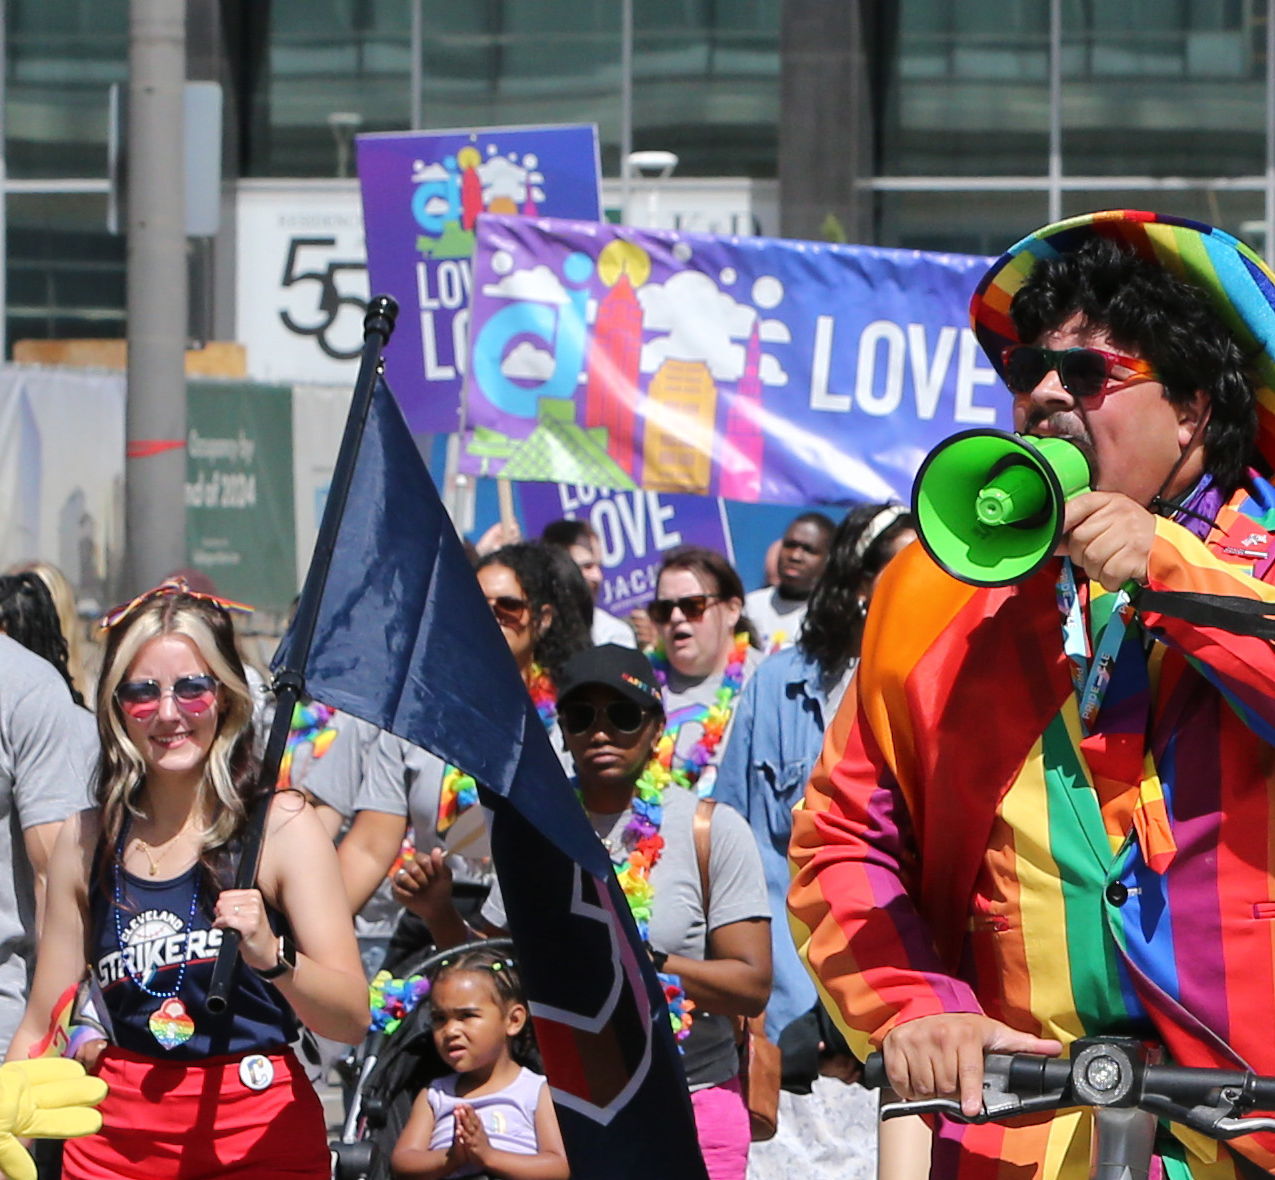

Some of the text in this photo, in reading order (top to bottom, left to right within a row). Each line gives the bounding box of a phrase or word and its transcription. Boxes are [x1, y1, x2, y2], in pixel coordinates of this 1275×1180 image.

[809, 314, 998, 424] LOVE
[185, 470, 204, 508] nd
[589, 489, 683, 569] OVE
[120, 909, 185, 943] CLEVELAND
[97, 928, 224, 989] STRIKERS
[246, 1057, 269, 1086] C
